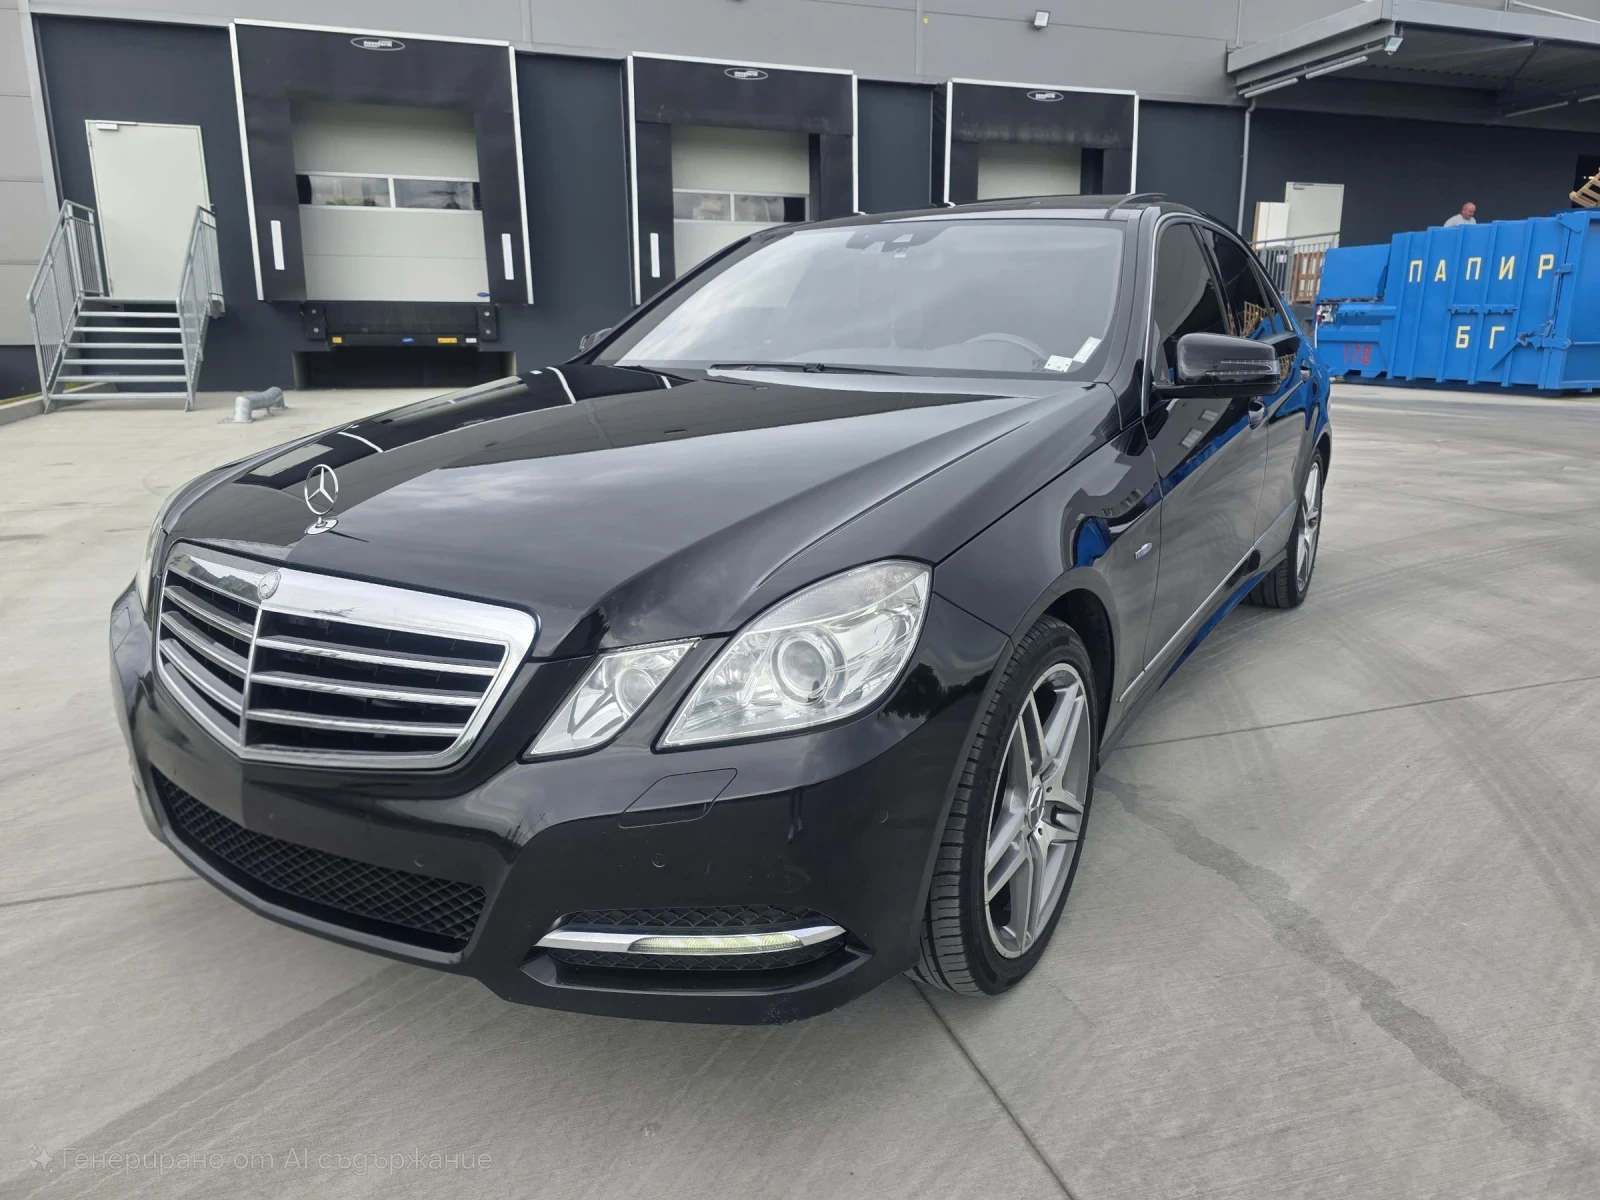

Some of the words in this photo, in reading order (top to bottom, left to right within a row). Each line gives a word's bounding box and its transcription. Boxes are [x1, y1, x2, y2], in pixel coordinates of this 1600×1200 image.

[1408, 253, 1555, 283] ПАПИР
[1455, 325, 1506, 350] БГ
[1343, 344, 1371, 365] 178
